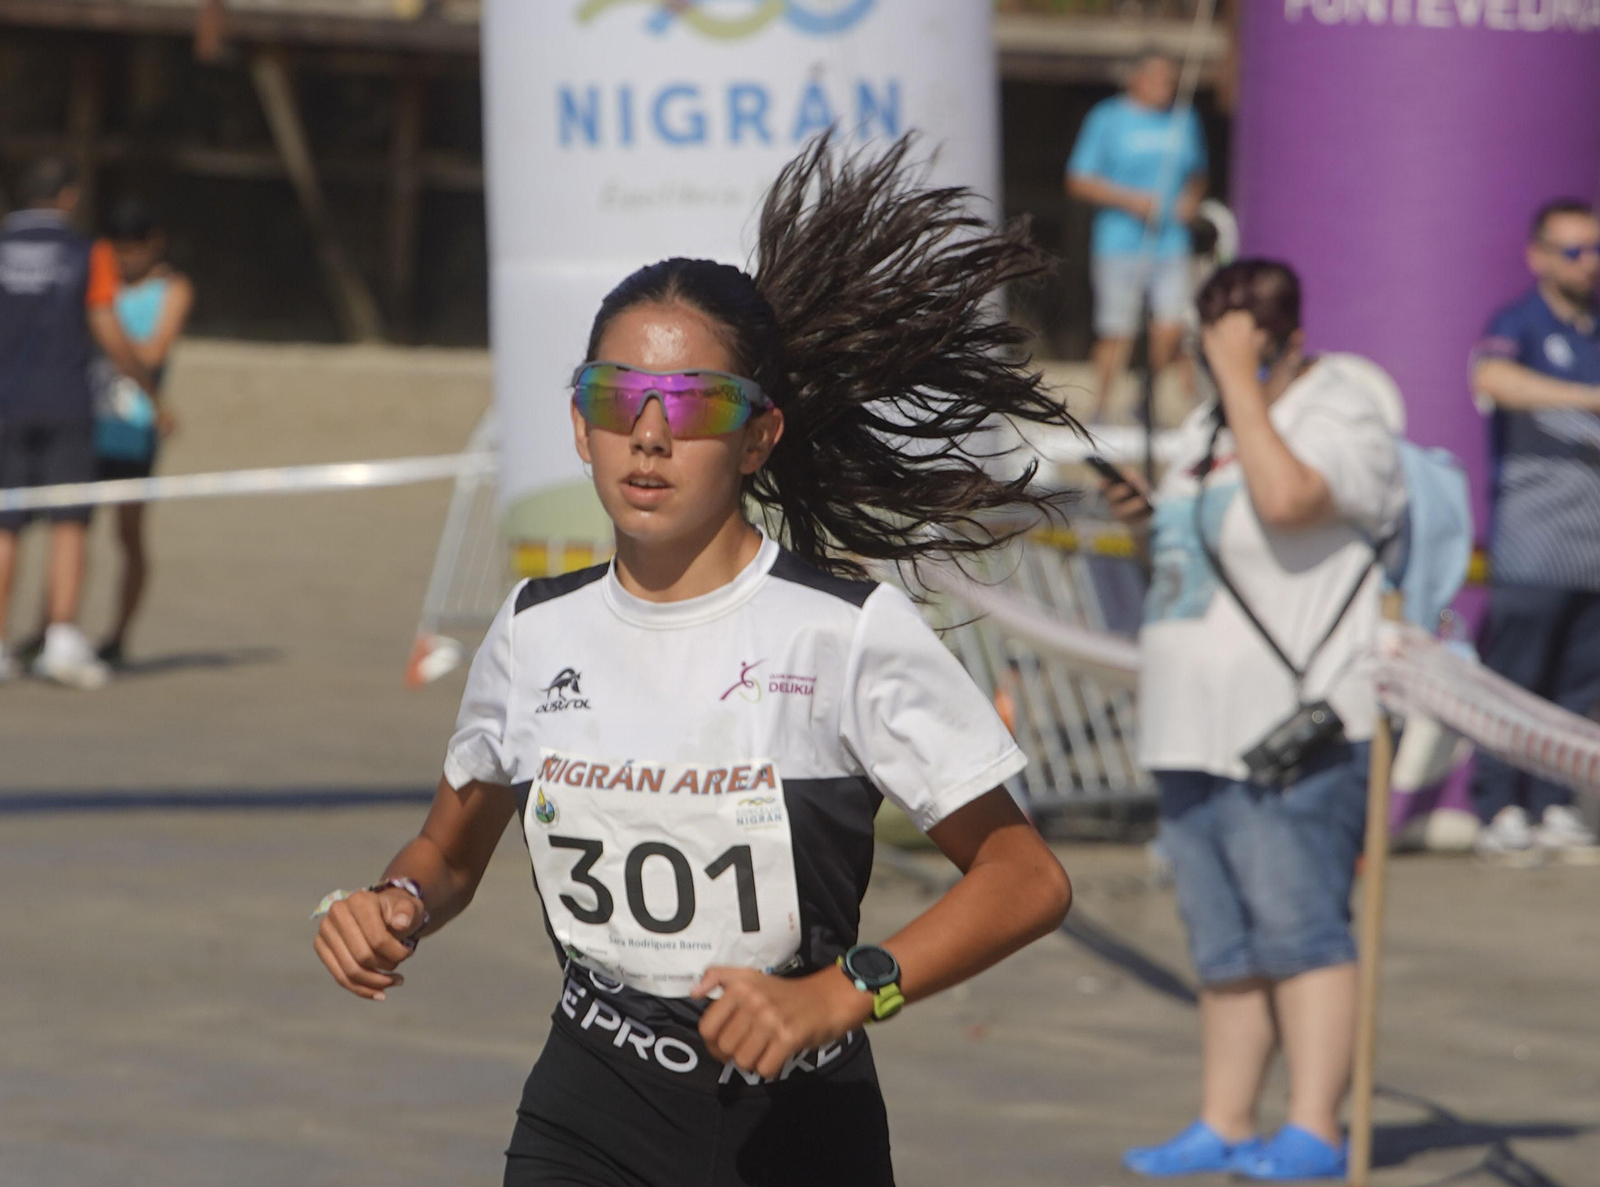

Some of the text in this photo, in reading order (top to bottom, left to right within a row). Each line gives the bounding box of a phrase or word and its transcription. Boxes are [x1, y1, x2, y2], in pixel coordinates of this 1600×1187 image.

[556, 60, 903, 148] NIGRÁN
[537, 757, 776, 795] NIGRÁN AREA
[548, 835, 760, 933] 301
[679, 940, 713, 950] Barros
[580, 998, 699, 1073] PRO
[717, 1038, 843, 1086] NKE
